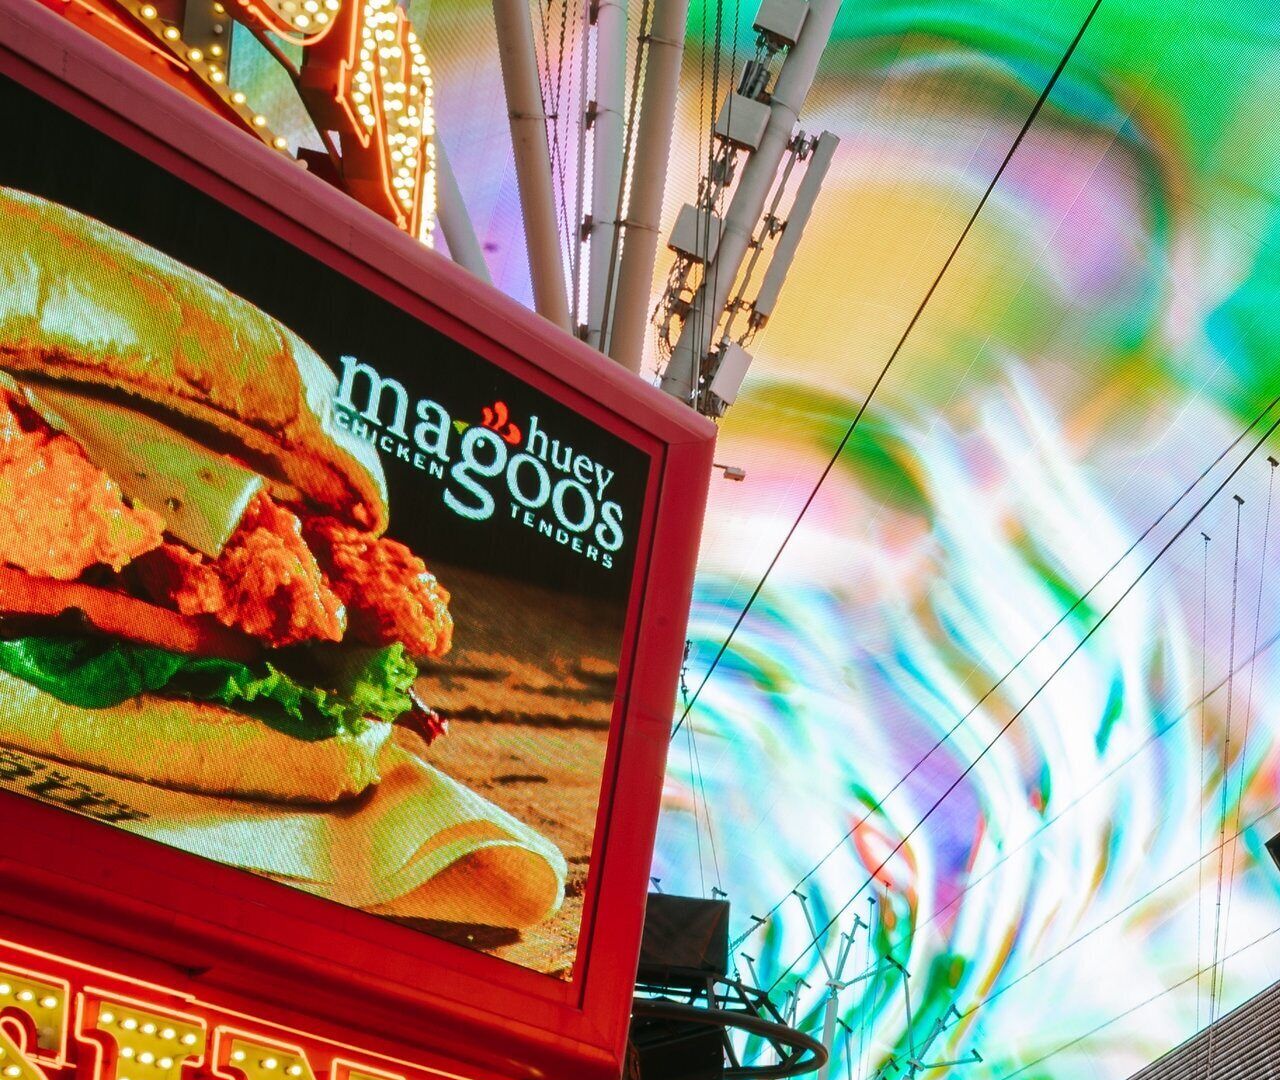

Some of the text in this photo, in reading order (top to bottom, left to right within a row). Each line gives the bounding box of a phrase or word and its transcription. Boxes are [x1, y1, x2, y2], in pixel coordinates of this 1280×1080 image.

[333, 411, 444, 480] CHICKEN
[333, 355, 624, 551] magoos
[526, 416, 614, 500] huey
[510, 503, 614, 569] TENDERS
